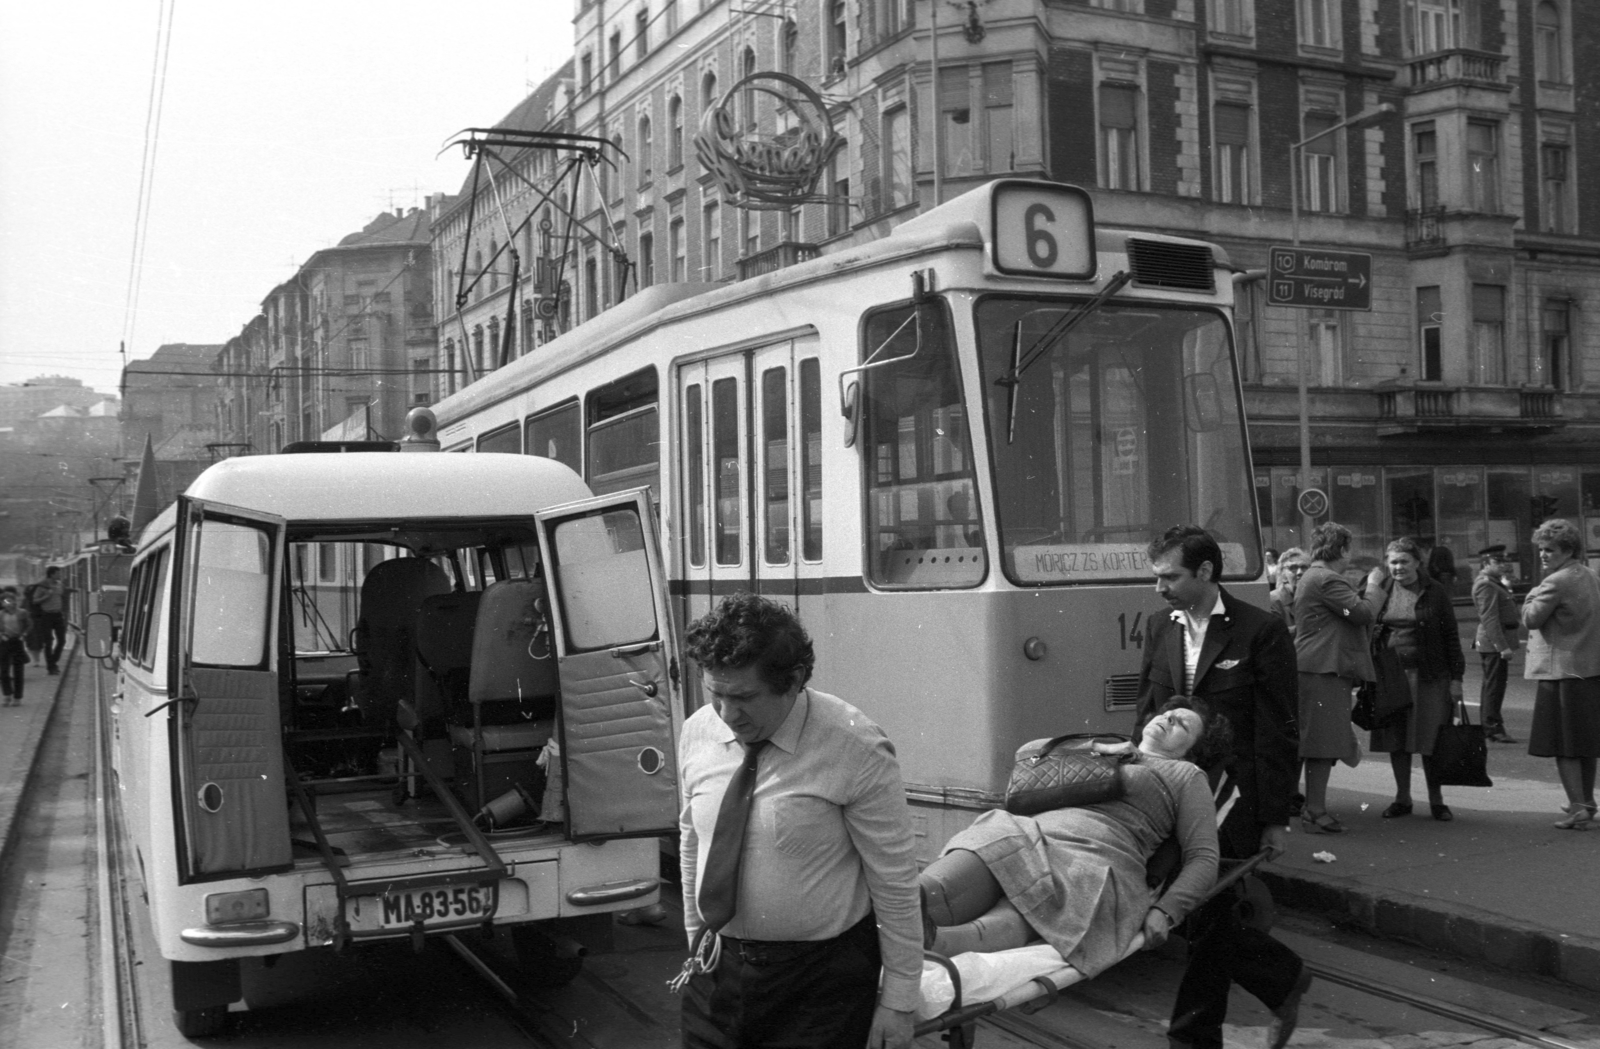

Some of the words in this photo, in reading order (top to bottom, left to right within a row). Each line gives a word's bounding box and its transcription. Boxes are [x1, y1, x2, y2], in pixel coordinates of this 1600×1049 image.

[1024, 203, 1058, 268] 6
[1278, 256, 1292, 268] 10
[1303, 255, 1347, 271] Komárom
[1279, 284, 1288, 296] 11
[1303, 284, 1345, 302] Visegrád
[1035, 550, 1079, 573] MÓRICZ
[1081, 552, 1098, 571] ZS
[1101, 548, 1148, 571] KÖRTÉR
